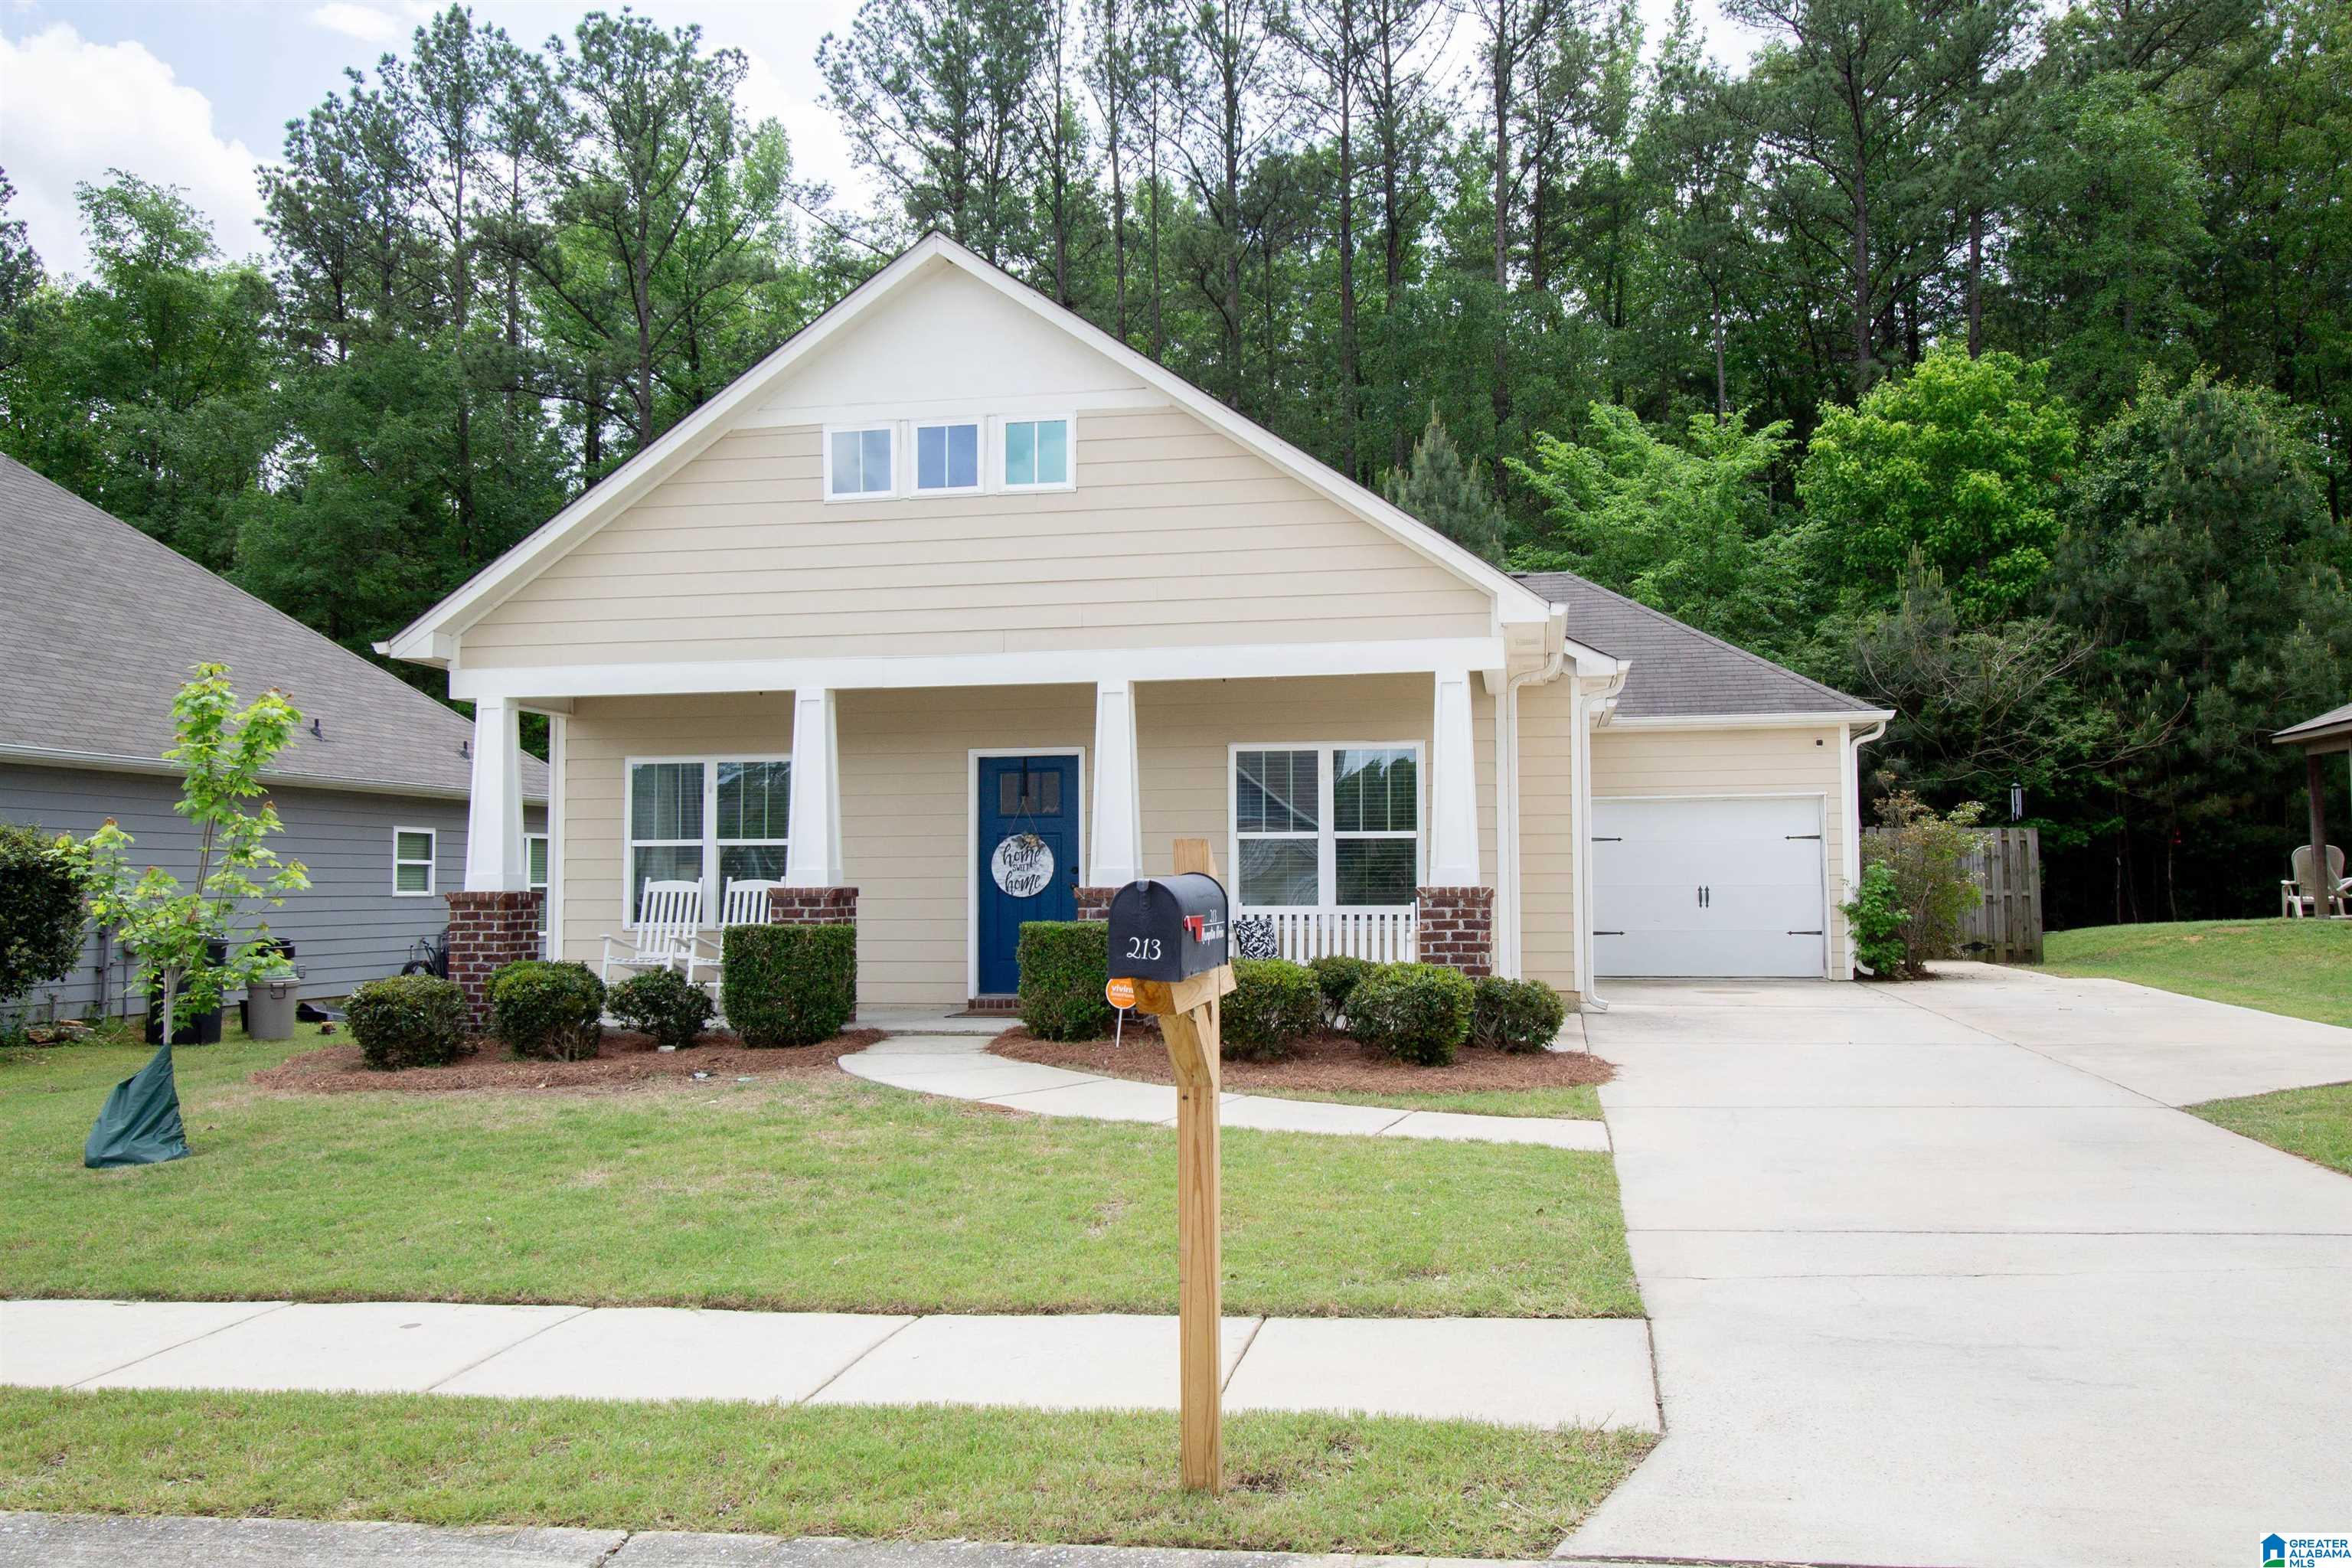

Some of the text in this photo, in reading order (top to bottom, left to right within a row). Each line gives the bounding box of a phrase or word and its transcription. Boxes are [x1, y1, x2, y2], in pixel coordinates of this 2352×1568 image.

[1003, 843, 1042, 867] home
[1012, 864, 1029, 872] SWEET
[1005, 871, 1041, 895] home
[1126, 936, 1161, 960] 213
